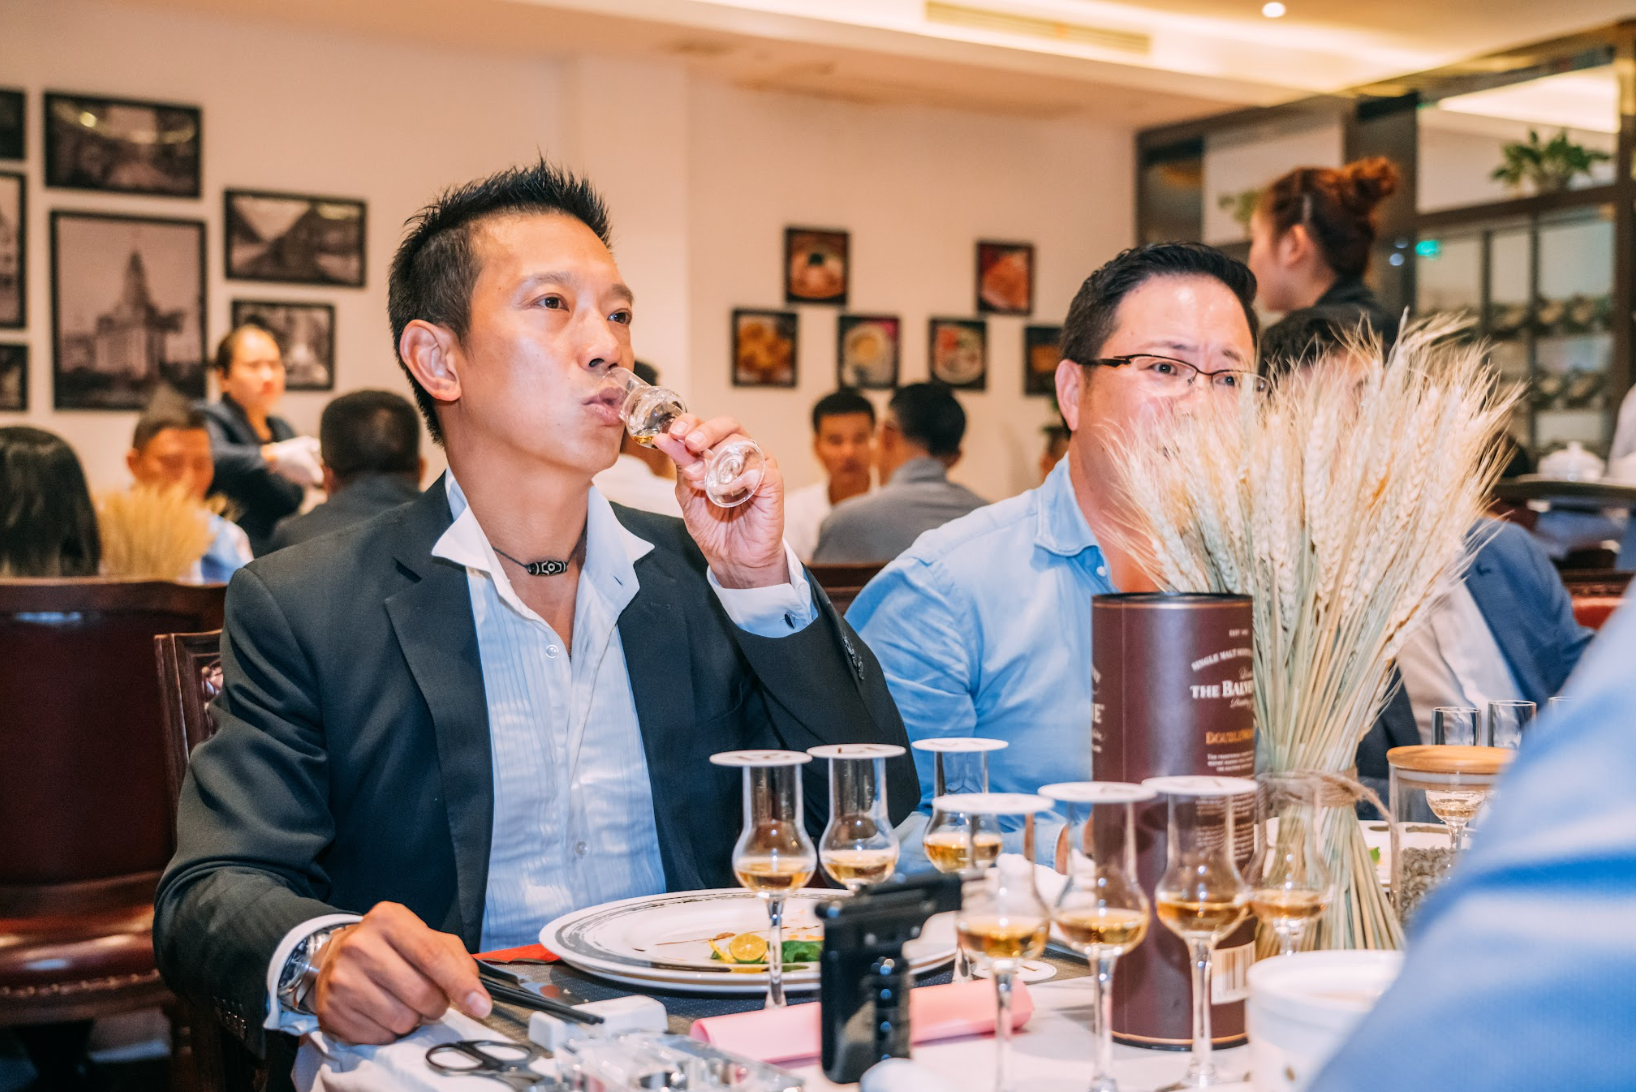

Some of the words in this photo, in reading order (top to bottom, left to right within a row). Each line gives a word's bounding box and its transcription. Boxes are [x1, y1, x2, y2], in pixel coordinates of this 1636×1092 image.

[1191, 653, 1219, 671] SINGLE
[1220, 648, 1236, 660] MALT
[1190, 685, 1219, 698] THE
